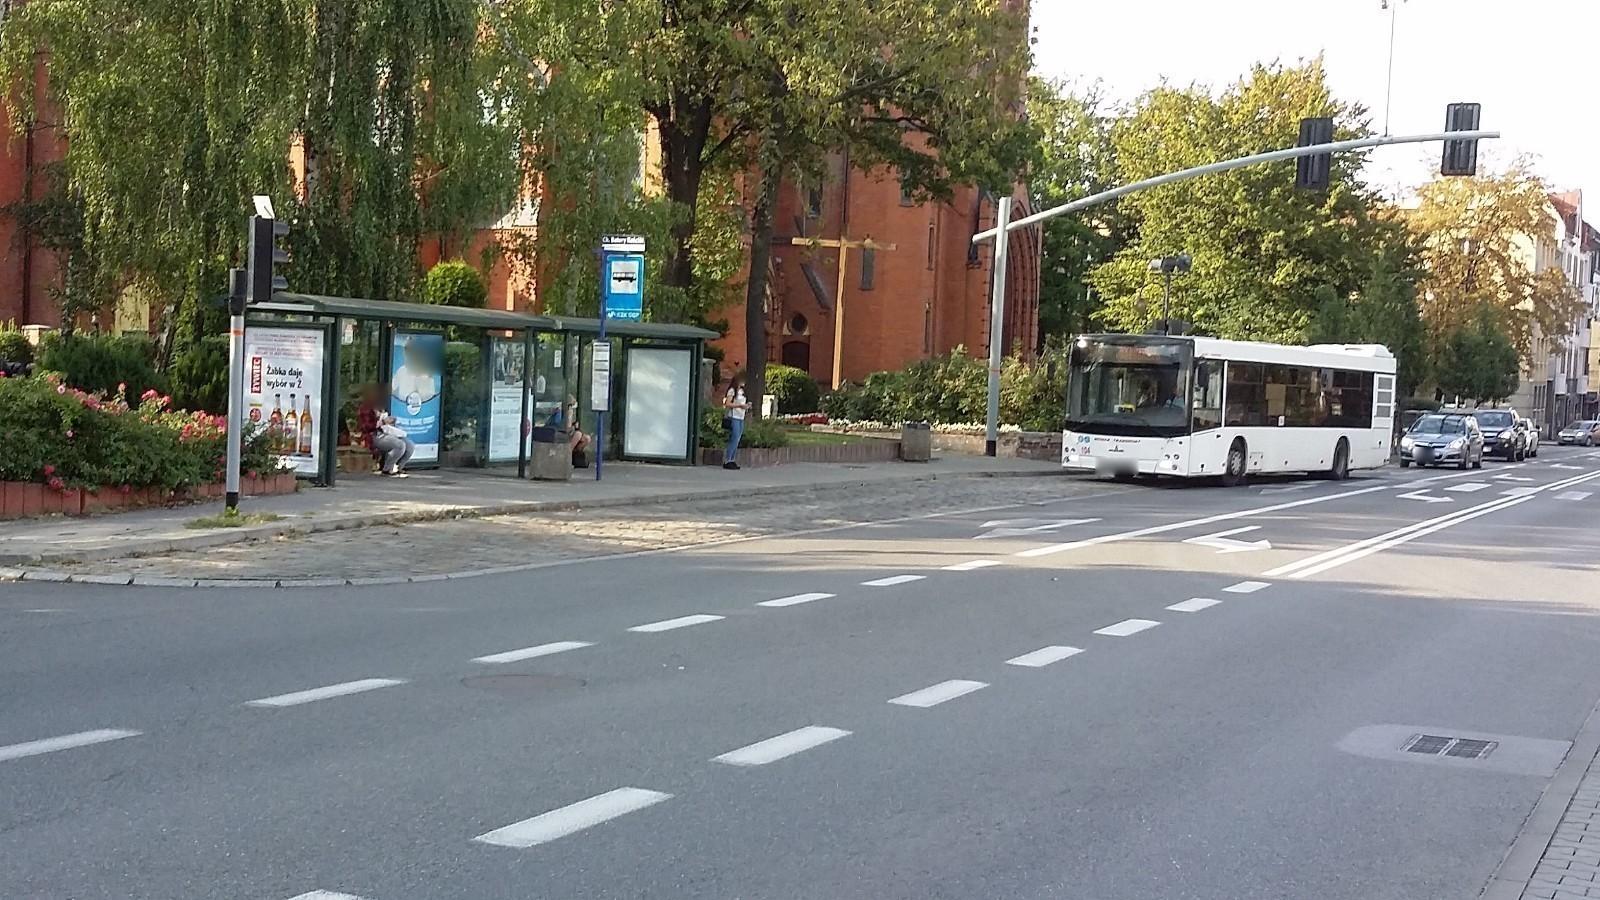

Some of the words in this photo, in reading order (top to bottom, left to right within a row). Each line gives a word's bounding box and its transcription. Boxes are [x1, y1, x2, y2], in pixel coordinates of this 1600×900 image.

[266, 364, 287, 376] Żabka
[288, 367, 303, 379] daje
[266, 379, 287, 389] wybór
